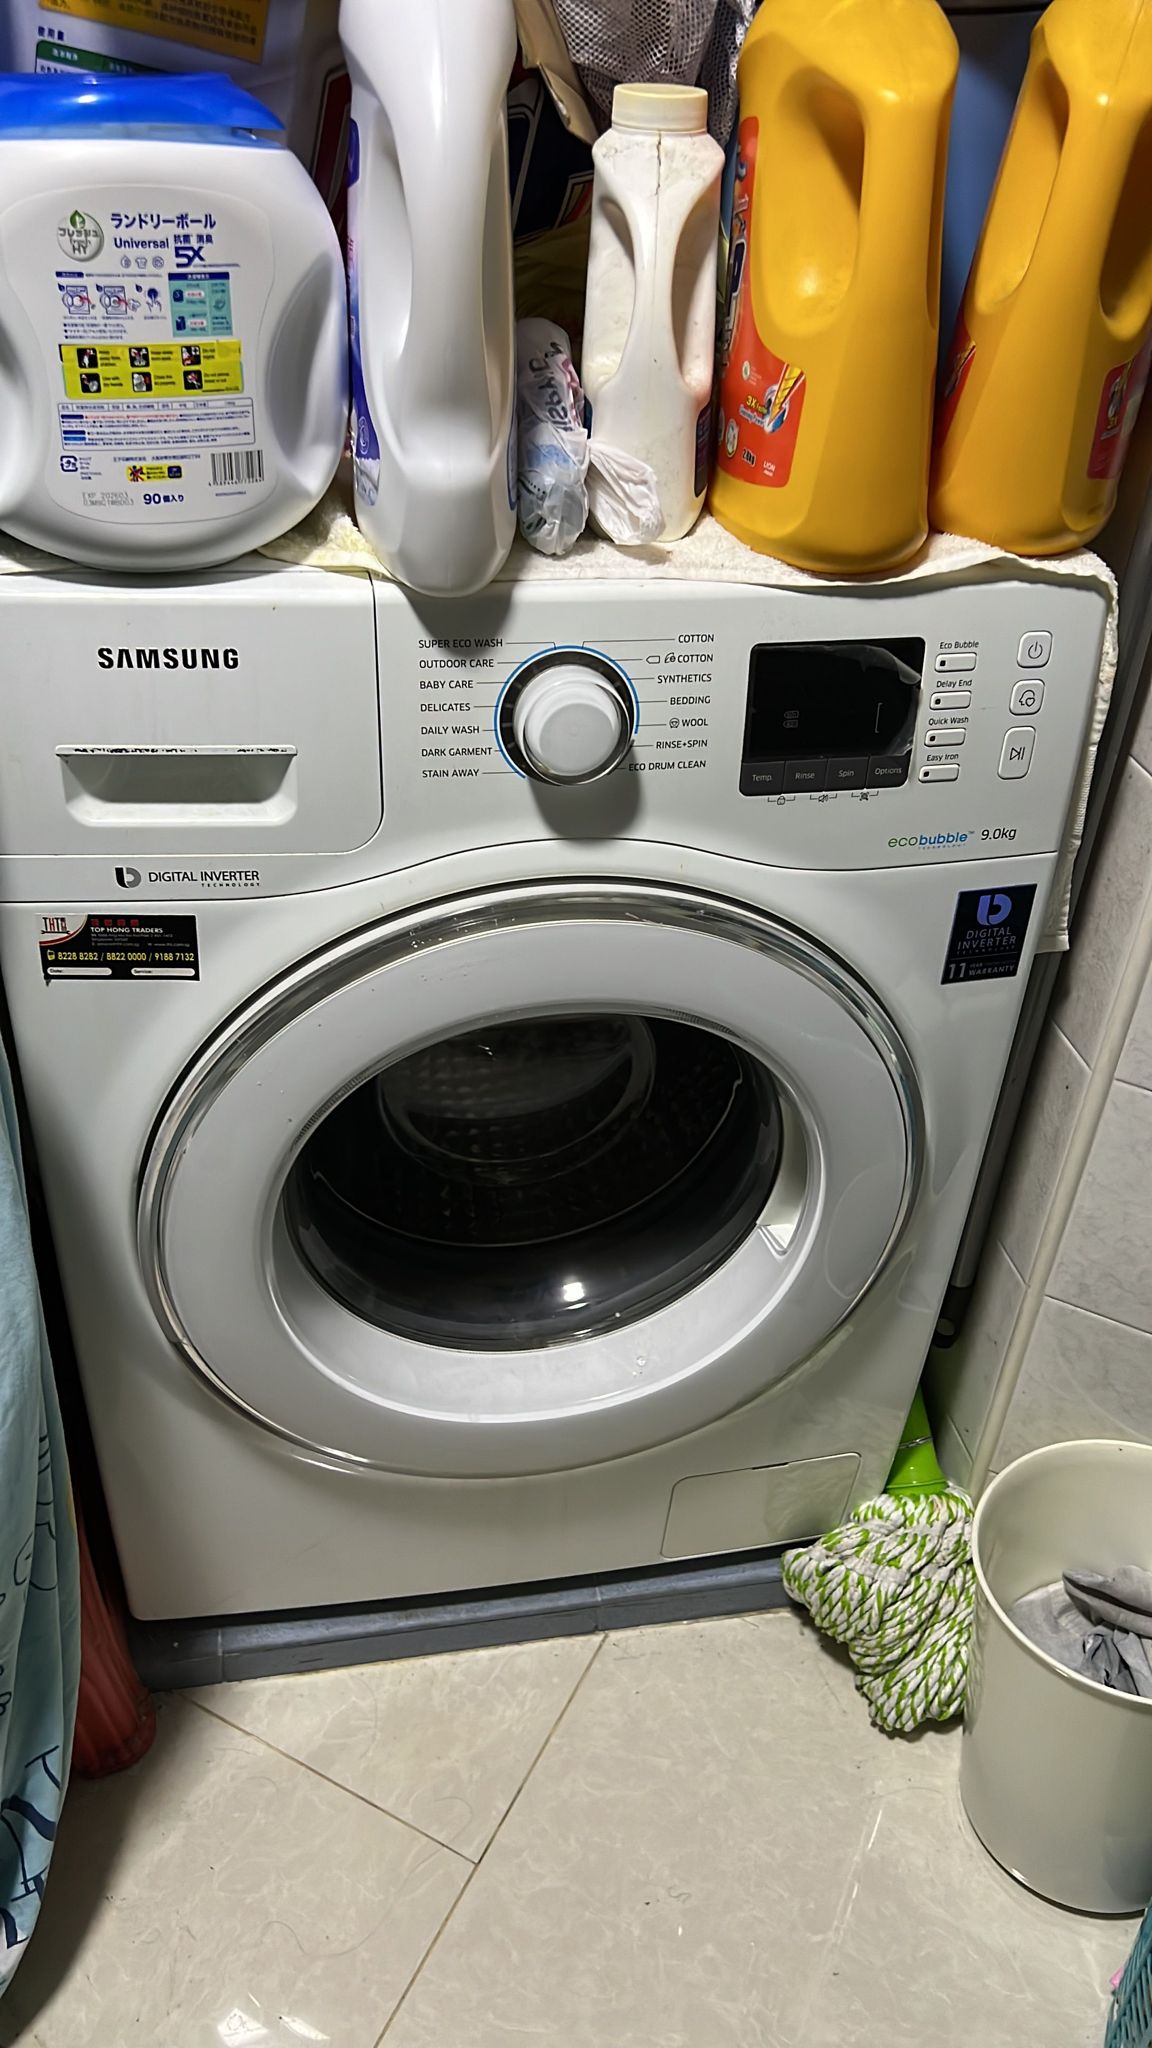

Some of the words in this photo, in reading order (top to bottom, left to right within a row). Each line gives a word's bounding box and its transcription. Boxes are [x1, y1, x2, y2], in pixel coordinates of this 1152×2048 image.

[110, 213, 216, 230] ランドリーボール
[114, 237, 170, 248] Universal
[174, 246, 206, 268] 5X
[418, 640, 450, 648] SUPER
[452, 639, 472, 648] ECO
[474, 638, 503, 648] WASH
[678, 634, 714, 644] COTTON
[940, 642, 952, 650] Eco
[954, 640, 979, 649] Bubble
[98, 648, 240, 669] SAMSUNG
[678, 654, 714, 663] COTTON
[419, 660, 466, 669] OUTDOOR
[470, 659, 494, 668] CARE
[658, 674, 712, 684] SYNTHETICS
[936, 680, 957, 688] Delay
[958, 679, 972, 687] End
[420, 680, 446, 689] BABY
[448, 680, 474, 688] CARE
[670, 696, 711, 706] BEDDING
[420, 703, 470, 712] DELICATES
[682, 718, 708, 727] WOOL
[928, 717, 948, 726] Quick
[950, 716, 969, 724] Wash
[421, 726, 448, 734] DAILY
[451, 726, 480, 734] WASH
[656, 740, 708, 749] RINSE+SPIN
[421, 748, 446, 757] DARK
[448, 747, 492, 756] GARMENT
[926, 754, 944, 762] Easy
[944, 752, 959, 760] Iron
[628, 762, 646, 772] ECO
[648, 762, 674, 770] DRUM
[678, 760, 706, 769] CLEAN
[874, 766, 902, 776] Options
[422, 770, 448, 778] STAIN
[452, 769, 480, 778] AWAY
[795, 772, 816, 780] Rinse
[838, 769, 855, 778] Spin
[980, 828, 1017, 840] 9.0kg
[148, 872, 198, 882] DIGITAL
[200, 870, 260, 882] INVERTER
[966, 926, 1012, 939] DIGITAL
[958, 936, 1017, 950] INVERTER
[58, 952, 78, 960] 8228
[79, 952, 98, 960] 8282
[106, 952, 126, 961] 8822
[128, 953, 147, 961] 0000
[154, 953, 174, 961] 9188
[175, 953, 194, 961] 7132
[949, 963, 966, 979] 11
[969, 965, 1015, 976] WARRANTY
